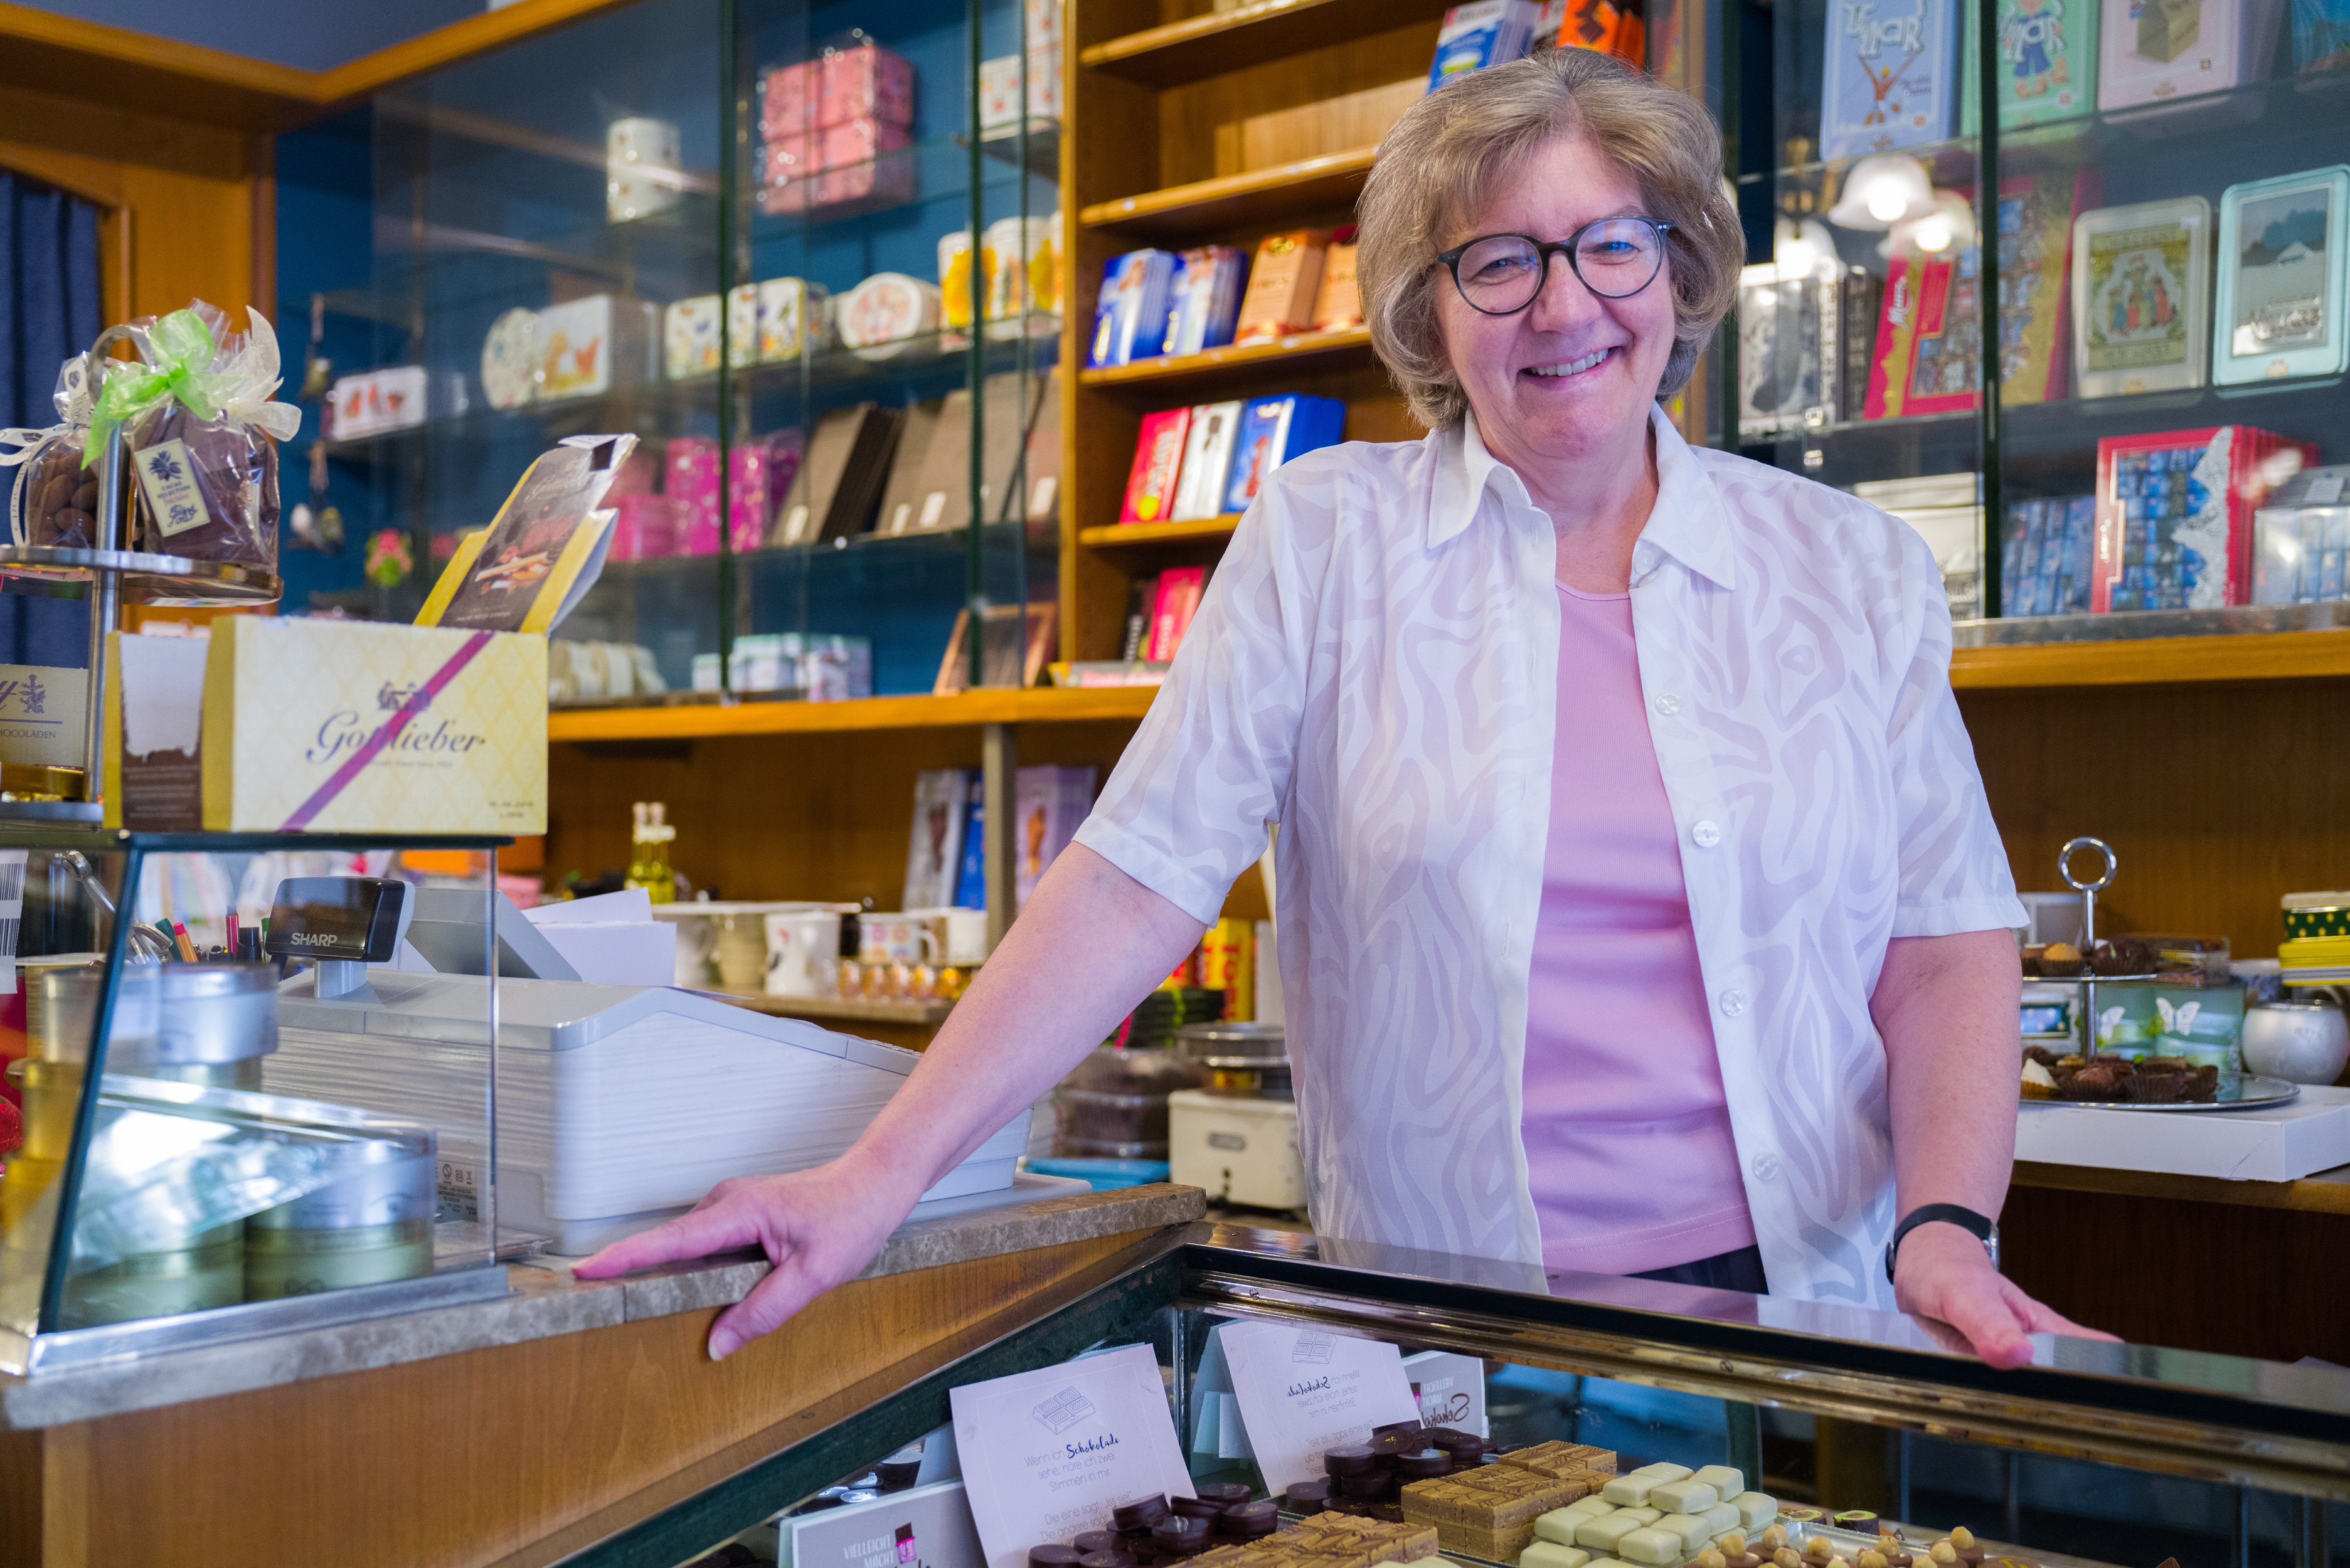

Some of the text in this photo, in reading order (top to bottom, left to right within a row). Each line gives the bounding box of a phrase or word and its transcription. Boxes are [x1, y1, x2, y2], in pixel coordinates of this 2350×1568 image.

[290, 932, 338, 947] SHARP
[1024, 1433, 1120, 1467] Wenn ich Schokolade
[1038, 1449, 1116, 1480] sehe, höre ich zwei
[1050, 1468, 1112, 1492] Stimmen in mir.
[1044, 1513, 1060, 1525] Die
[1061, 1508, 1080, 1520] eine
[1081, 1500, 1102, 1514] sagt:
[1040, 1530, 1056, 1542] Die
[1057, 1521, 1089, 1537] andere
[843, 1534, 891, 1560] VIELLEICHT
[864, 1550, 895, 1568] MACHT
